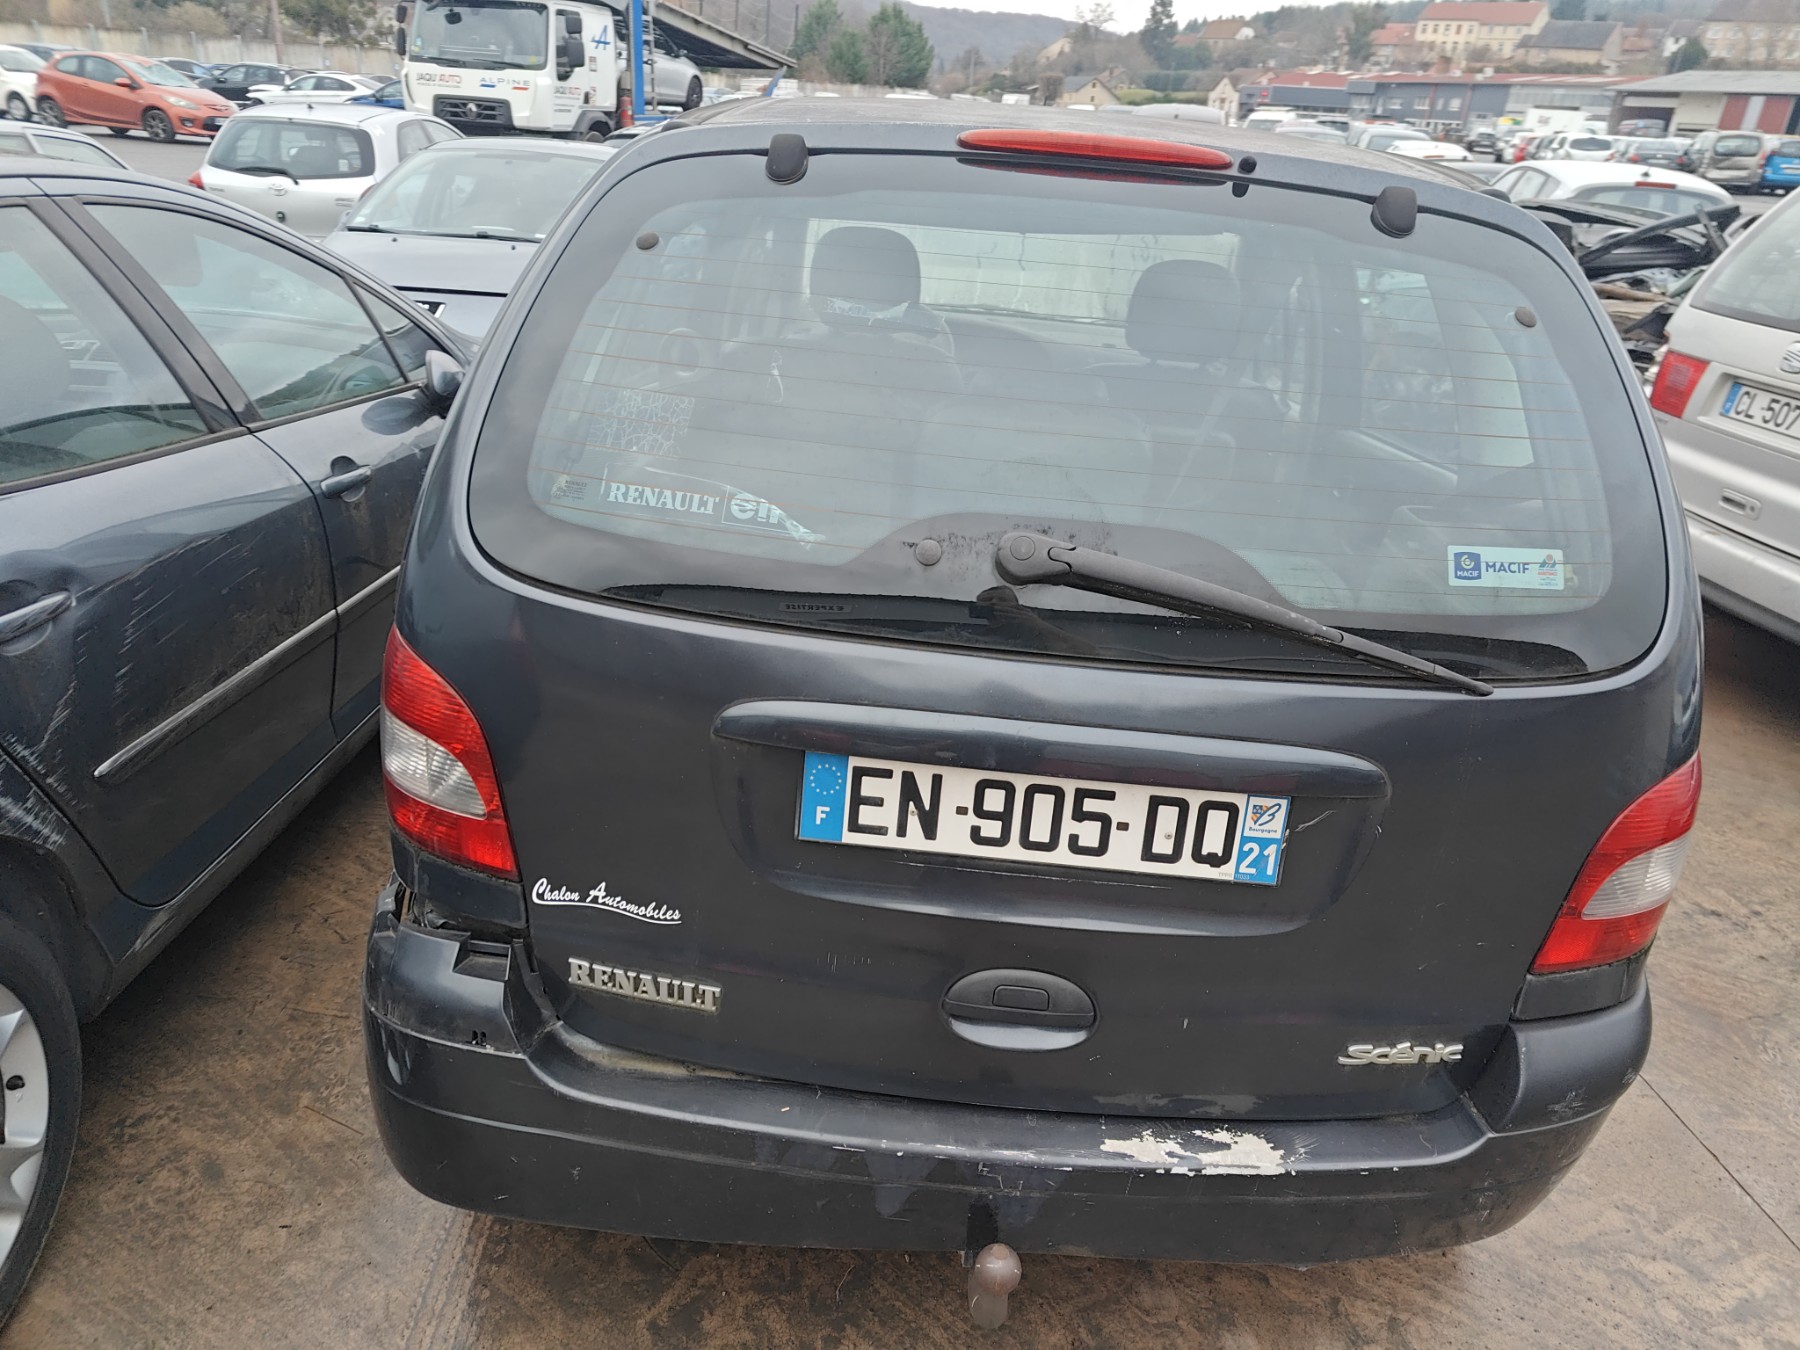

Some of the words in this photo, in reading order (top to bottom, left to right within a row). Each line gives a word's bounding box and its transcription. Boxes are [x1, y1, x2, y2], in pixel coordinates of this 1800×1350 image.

[479, 77, 530, 87] ALPINE
[606, 482, 720, 515] RENAULT
[1456, 570, 1480, 578] MACIF
[1485, 561, 1530, 574] MACIF
[815, 806, 829, 826] F
[847, 765, 1241, 869] EN-905-DQ
[1248, 826, 1278, 834] Bourgogne
[1238, 841, 1278, 876] 21
[531, 877, 581, 906] Chalon
[585, 881, 682, 921] Automobiles
[568, 957, 722, 1013] RENAULT
[1337, 1041, 1464, 1065] Scénic
